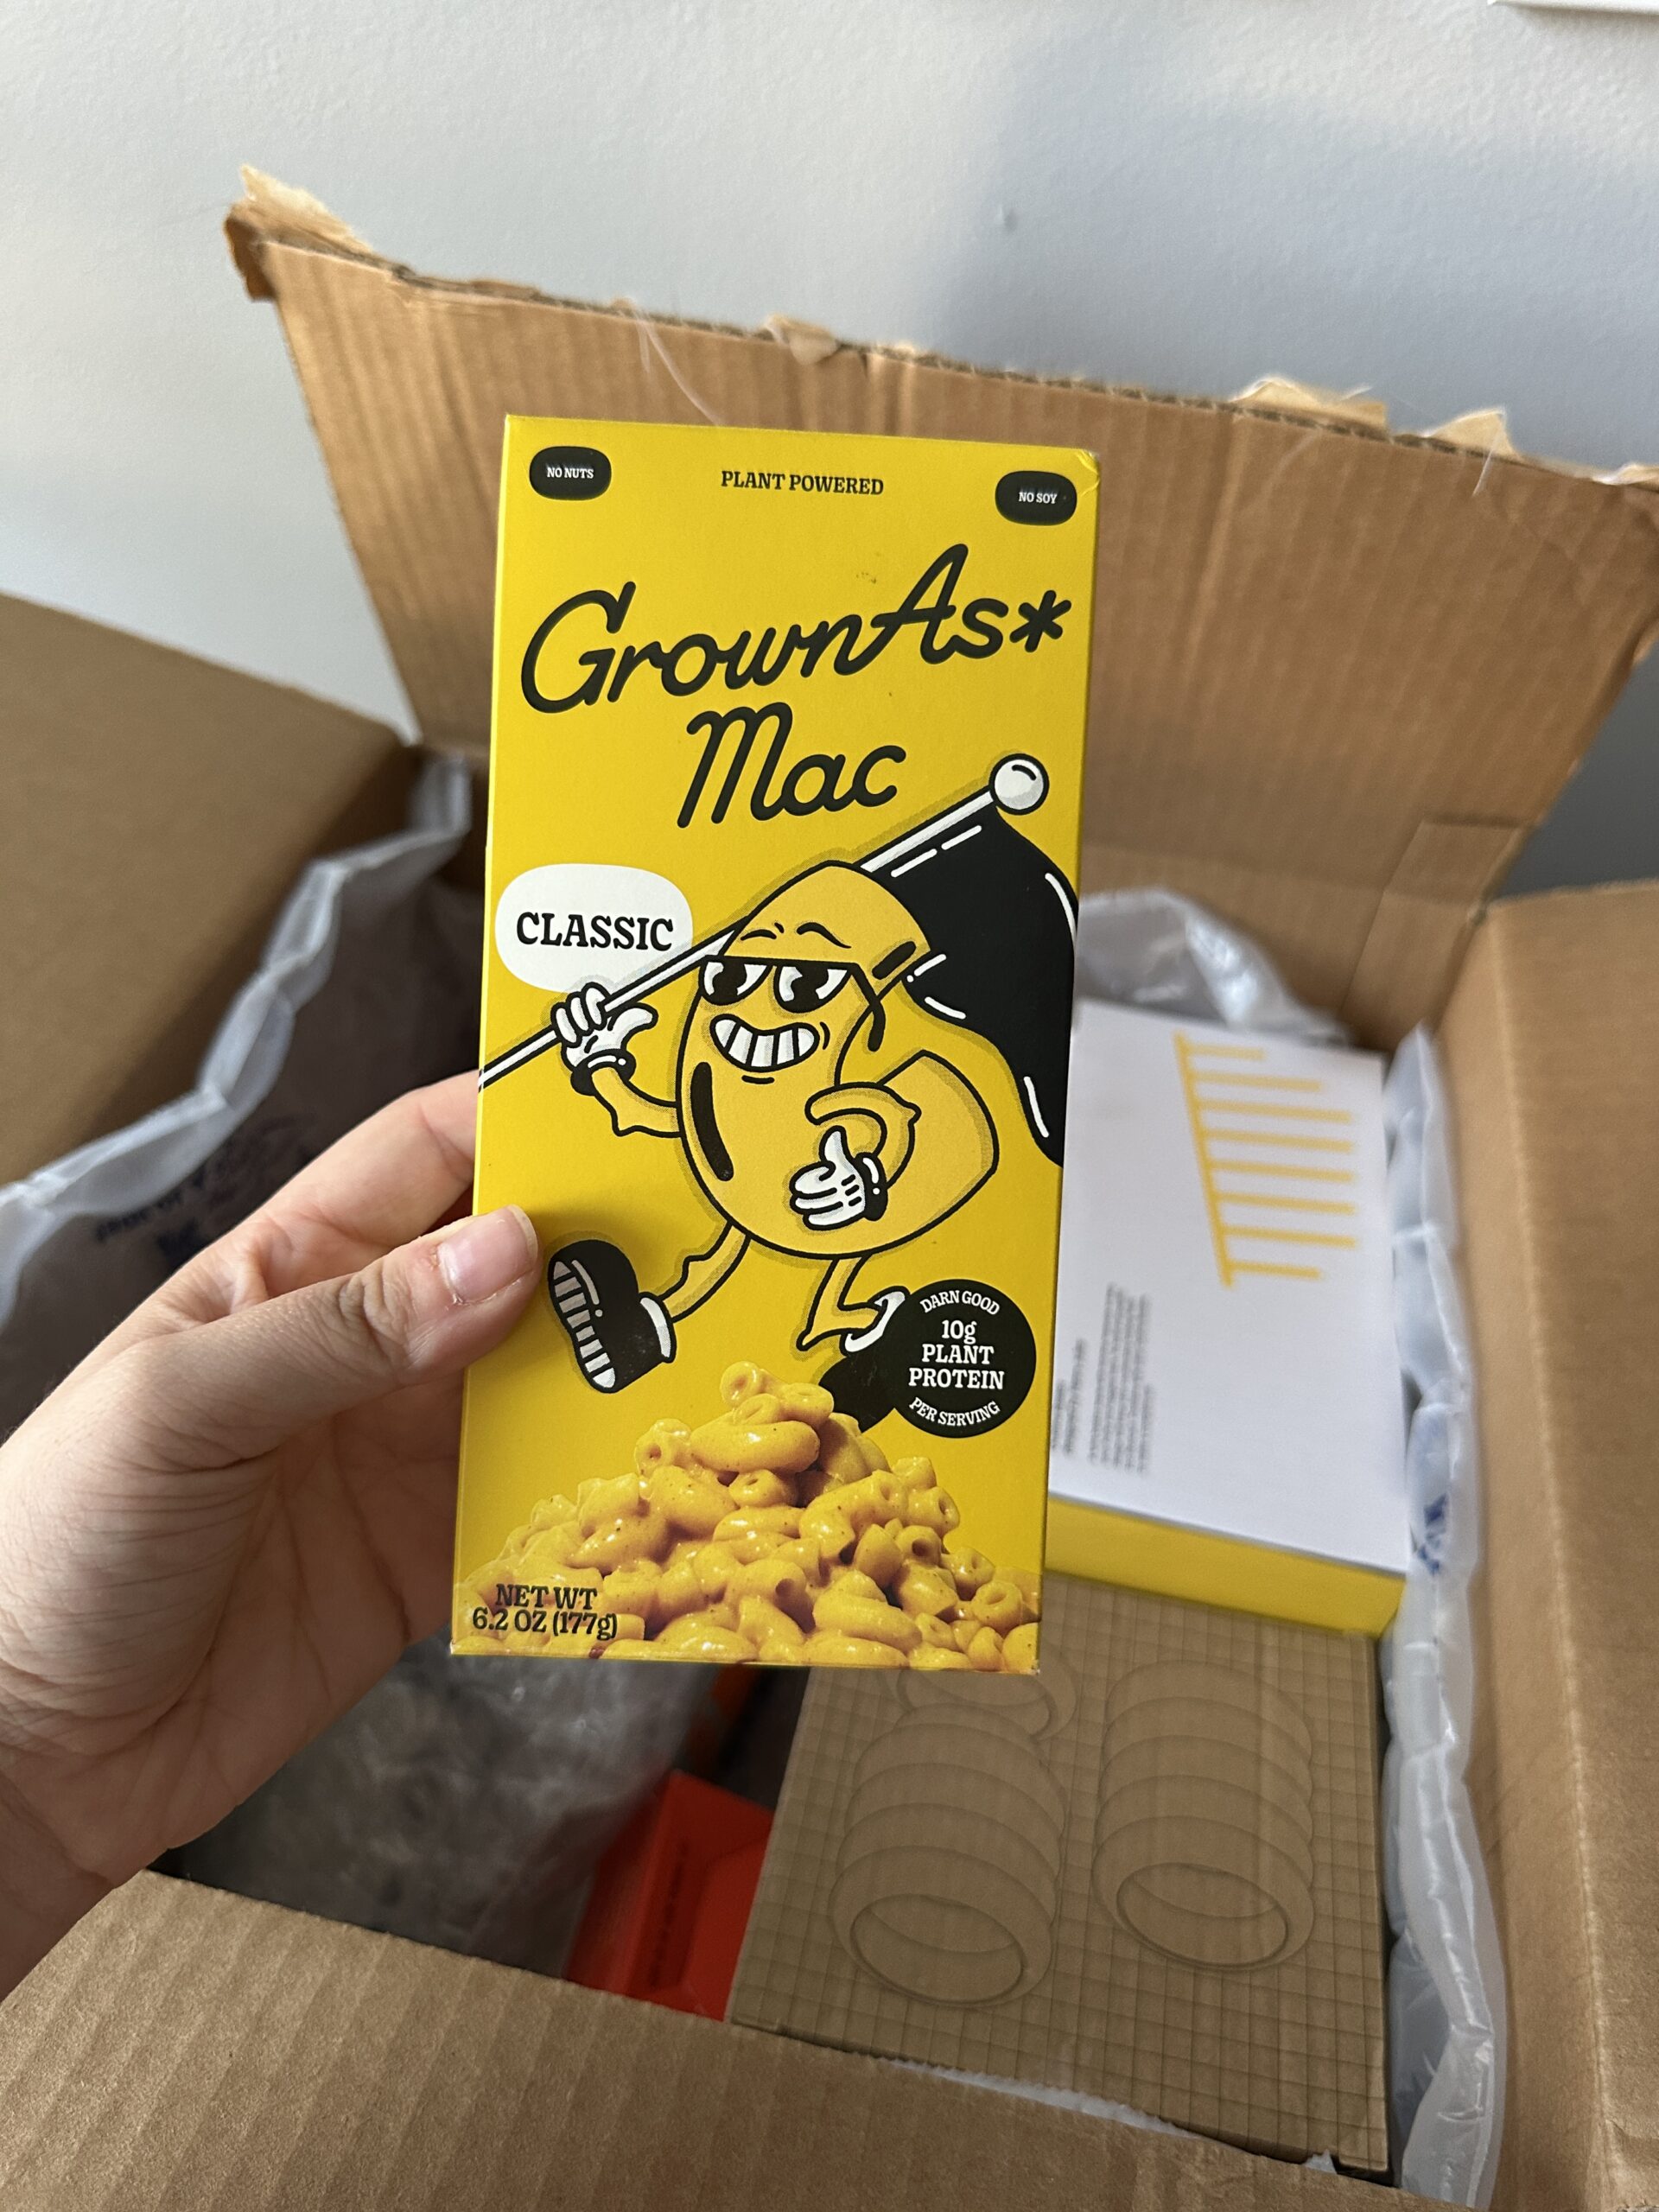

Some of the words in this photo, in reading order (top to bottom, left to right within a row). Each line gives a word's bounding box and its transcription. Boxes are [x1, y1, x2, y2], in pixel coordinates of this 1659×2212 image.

[547, 467, 563, 478] NO
[564, 467, 594, 479] NUTS
[721, 470, 785, 490] PLANT
[789, 474, 884, 495] POWERED
[1018, 492, 1035, 503] NO
[1035, 493, 1058, 505] SOY
[677, 702, 906, 828] Mac
[517, 912, 674, 951] CLASSIC
[919, 1290, 960, 1313] DARN
[961, 1290, 1001, 1315] GOOD
[941, 1319, 978, 1344] 10g
[921, 1344, 995, 1364] PLANT
[908, 1367, 1005, 1390] PROTEIN
[908, 1396, 938, 1422] PER
[938, 1400, 1001, 1426] SERVING
[495, 1583, 550, 1608] NET
[553, 1586, 598, 1610] WT
[472, 1606, 509, 1630] 6.2
[514, 1609, 547, 1633] OZ
[552, 1611, 618, 1641] (177g)
